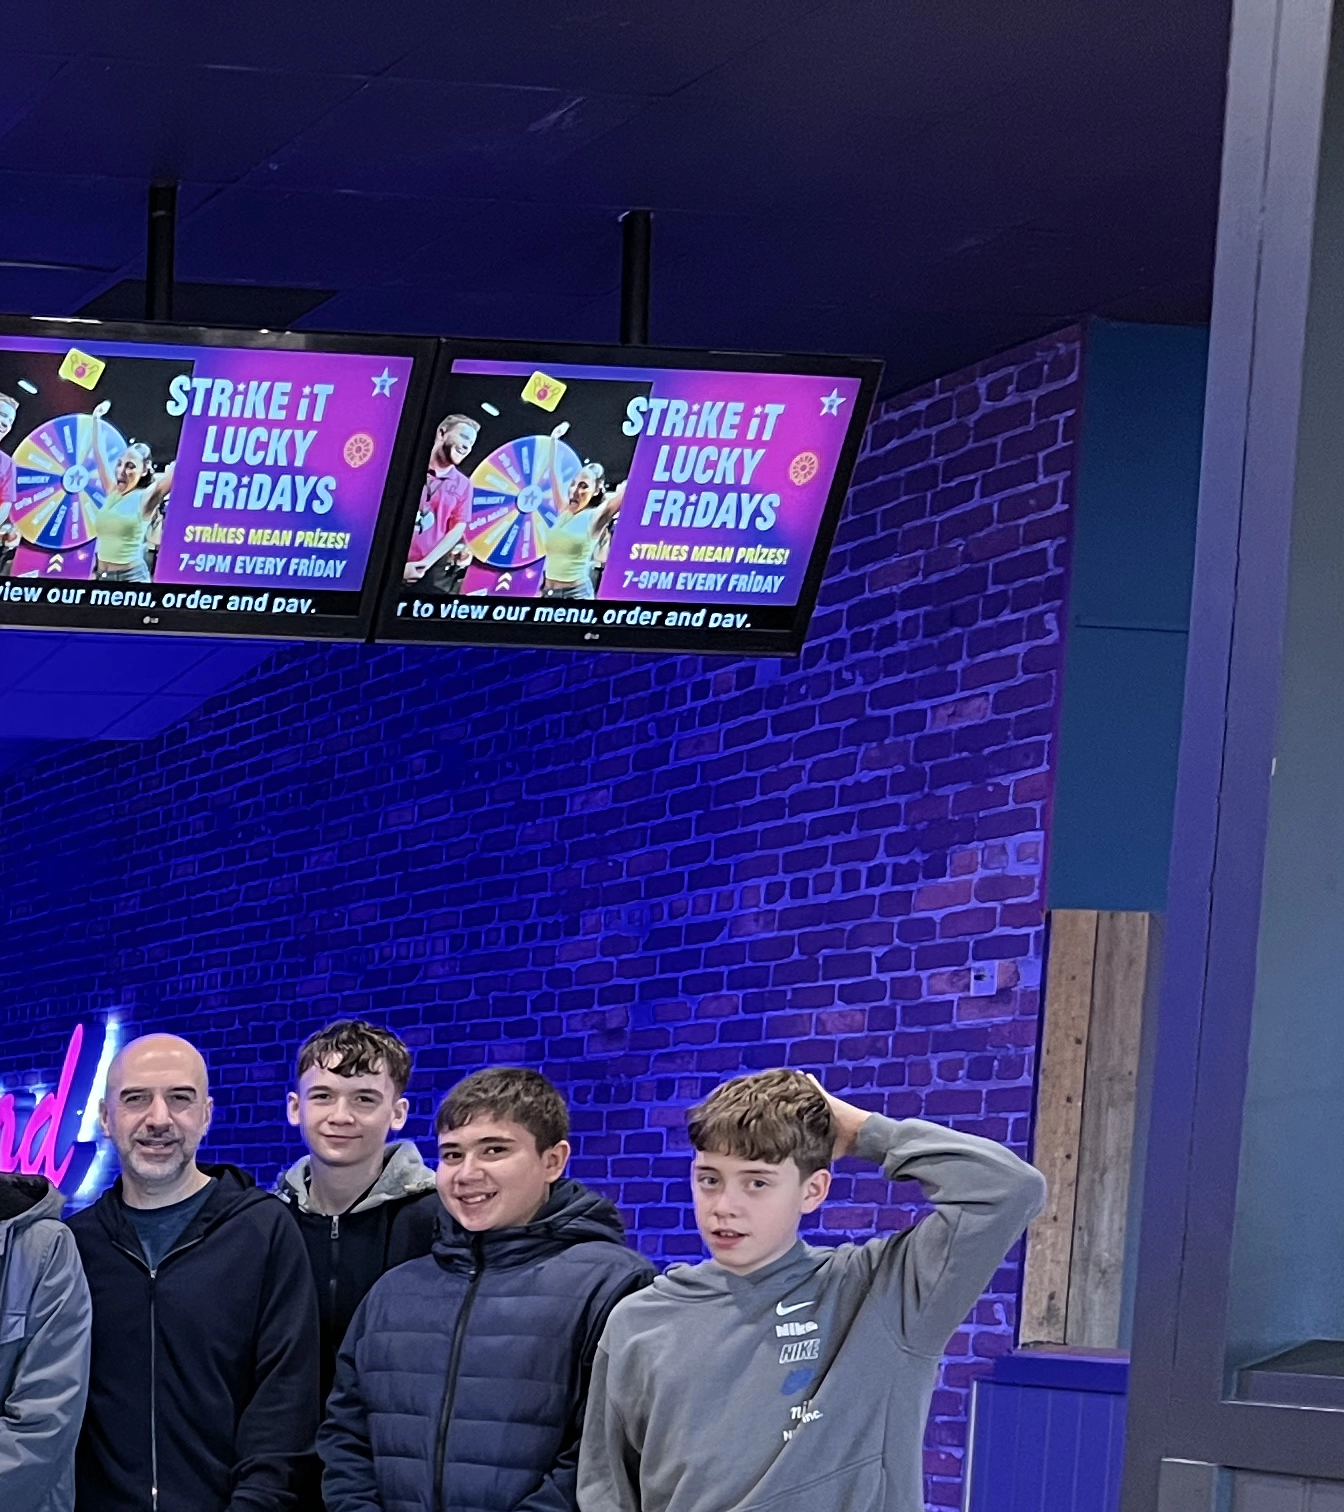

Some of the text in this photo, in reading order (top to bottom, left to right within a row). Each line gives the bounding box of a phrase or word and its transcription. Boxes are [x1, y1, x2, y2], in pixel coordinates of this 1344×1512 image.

[202, 425, 317, 467] LUCKY
[653, 445, 765, 486] LUCKY
[249, 529, 292, 547] MEAN
[179, 554, 231, 573] 7-9PM
[235, 556, 285, 576] EVERY
[692, 545, 733, 563] MEAN
[623, 571, 672, 589] 7-9PM
[677, 572, 726, 592] EVERY
[47, 588, 85, 605] our
[90, 588, 157, 611] menu,
[162, 588, 223, 611] order
[227, 592, 266, 613] and
[412, 600, 434, 617] to
[440, 600, 487, 619] view
[492, 604, 530, 621] our
[533, 606, 598, 626] menu,
[603, 606, 663, 627] order
[666, 609, 705, 628] and
[778, 1339, 821, 1364] NIKE
